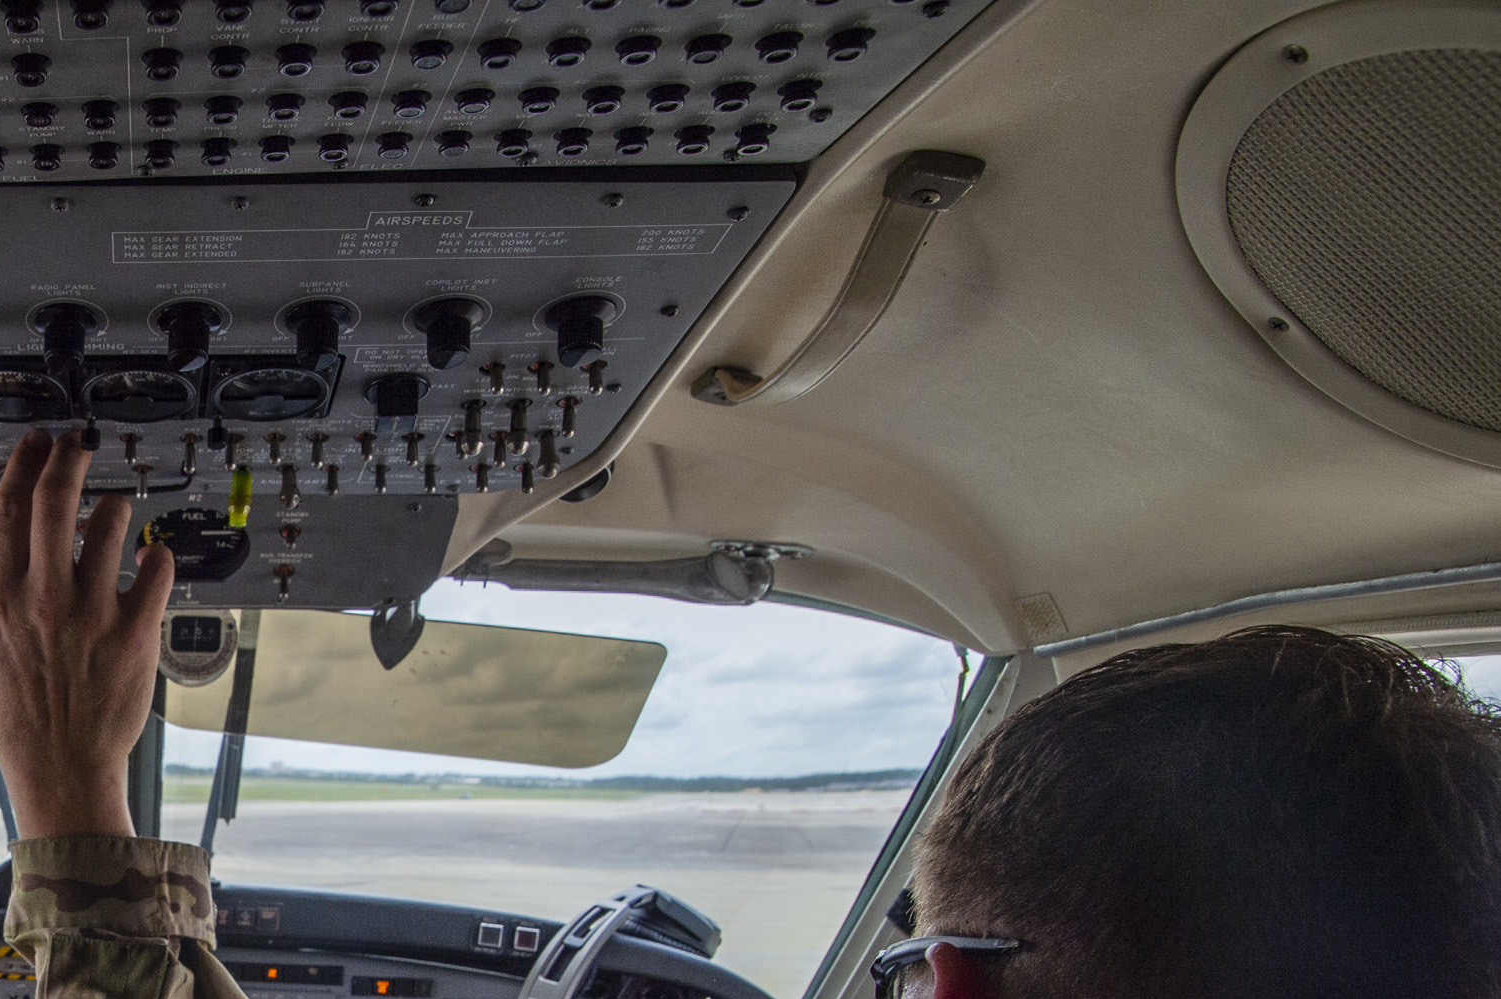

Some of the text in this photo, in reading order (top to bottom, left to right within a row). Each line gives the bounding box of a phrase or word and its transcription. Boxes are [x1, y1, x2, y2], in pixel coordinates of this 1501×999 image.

[210, 33, 249, 41] CONTR
[541, 158, 617, 166] AVIONICS
[212, 167, 267, 175] ENGINE
[374, 215, 463, 226] AIRSPEEDS
[471, 231, 529, 239] APPROACH
[668, 228, 705, 236] KNOTS
[468, 239, 494, 247] FULL
[657, 243, 695, 251] KNOTS
[185, 250, 237, 258] EXTENDED
[464, 246, 537, 254] MANEUVERING
[182, 512, 207, 520] FUEL
